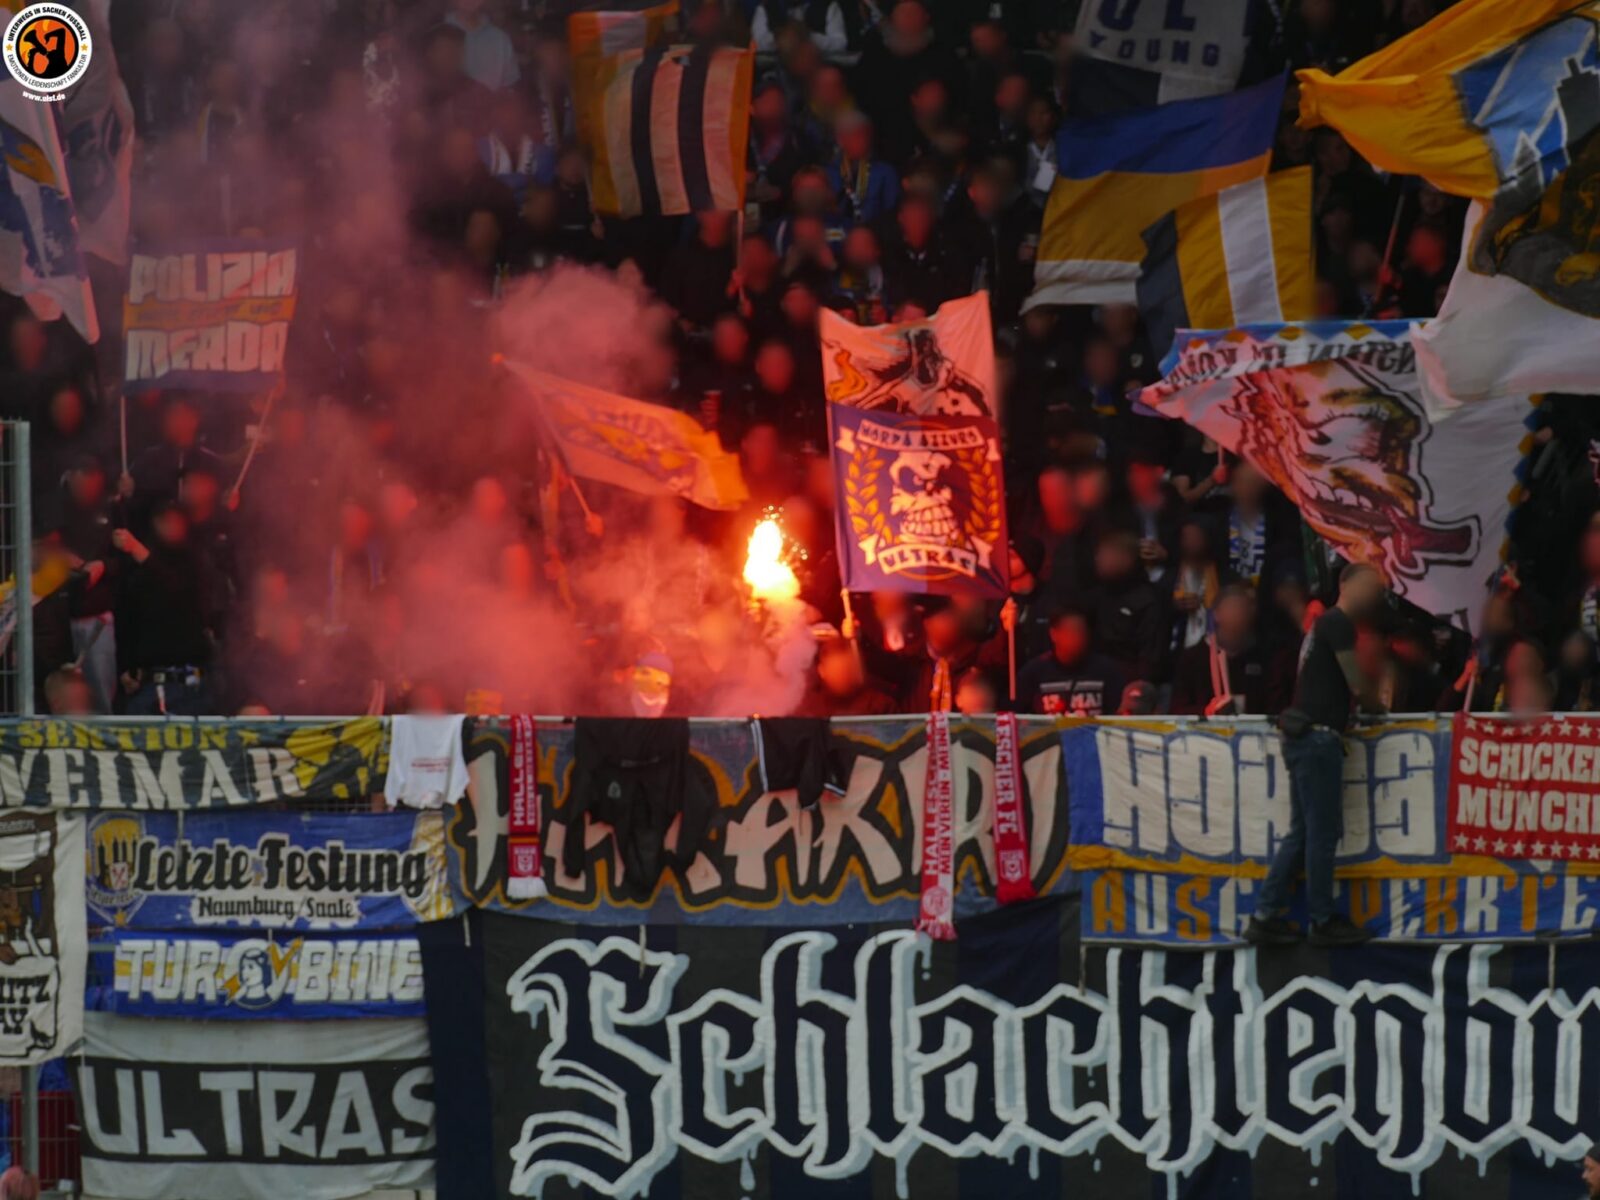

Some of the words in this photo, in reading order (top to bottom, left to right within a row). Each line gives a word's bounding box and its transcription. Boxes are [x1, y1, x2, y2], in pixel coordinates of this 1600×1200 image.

[1088, 29, 1220, 67] YOUNG
[128, 249, 297, 304] POLIZIA
[125, 321, 289, 381] MERDA
[938, 780, 951, 833] VEREIN
[998, 810, 1018, 834] FC
[133, 839, 251, 892] Letzte
[258, 837, 429, 898] Festung
[77, 1063, 436, 1159] ULTRAS
